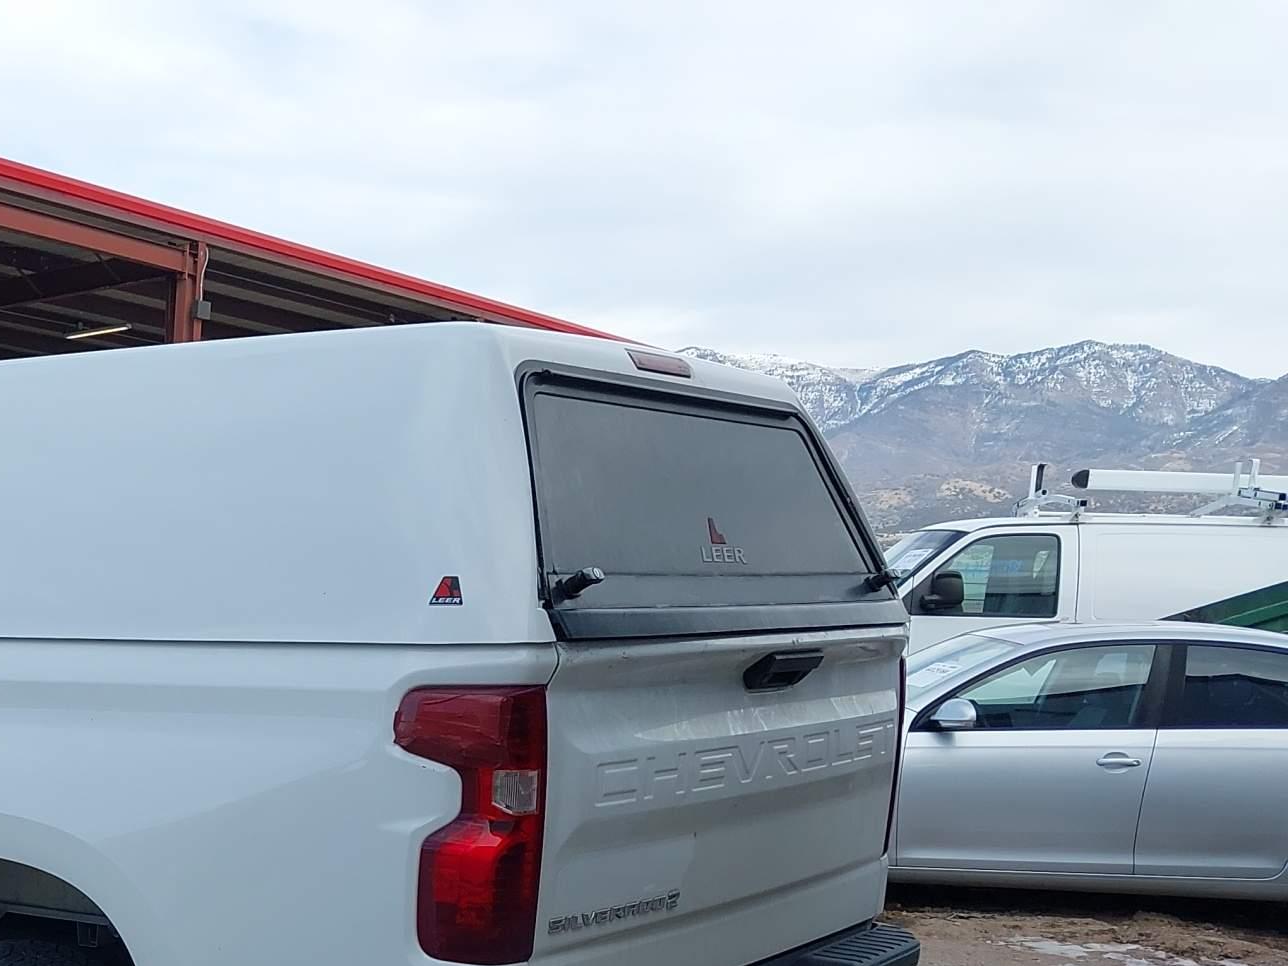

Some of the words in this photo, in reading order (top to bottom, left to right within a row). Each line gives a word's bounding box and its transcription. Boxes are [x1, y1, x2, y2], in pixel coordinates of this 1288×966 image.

[700, 545, 747, 565] LEER
[594, 718, 894, 807] CHEVROLET
[548, 894, 666, 935] SILVERADO
